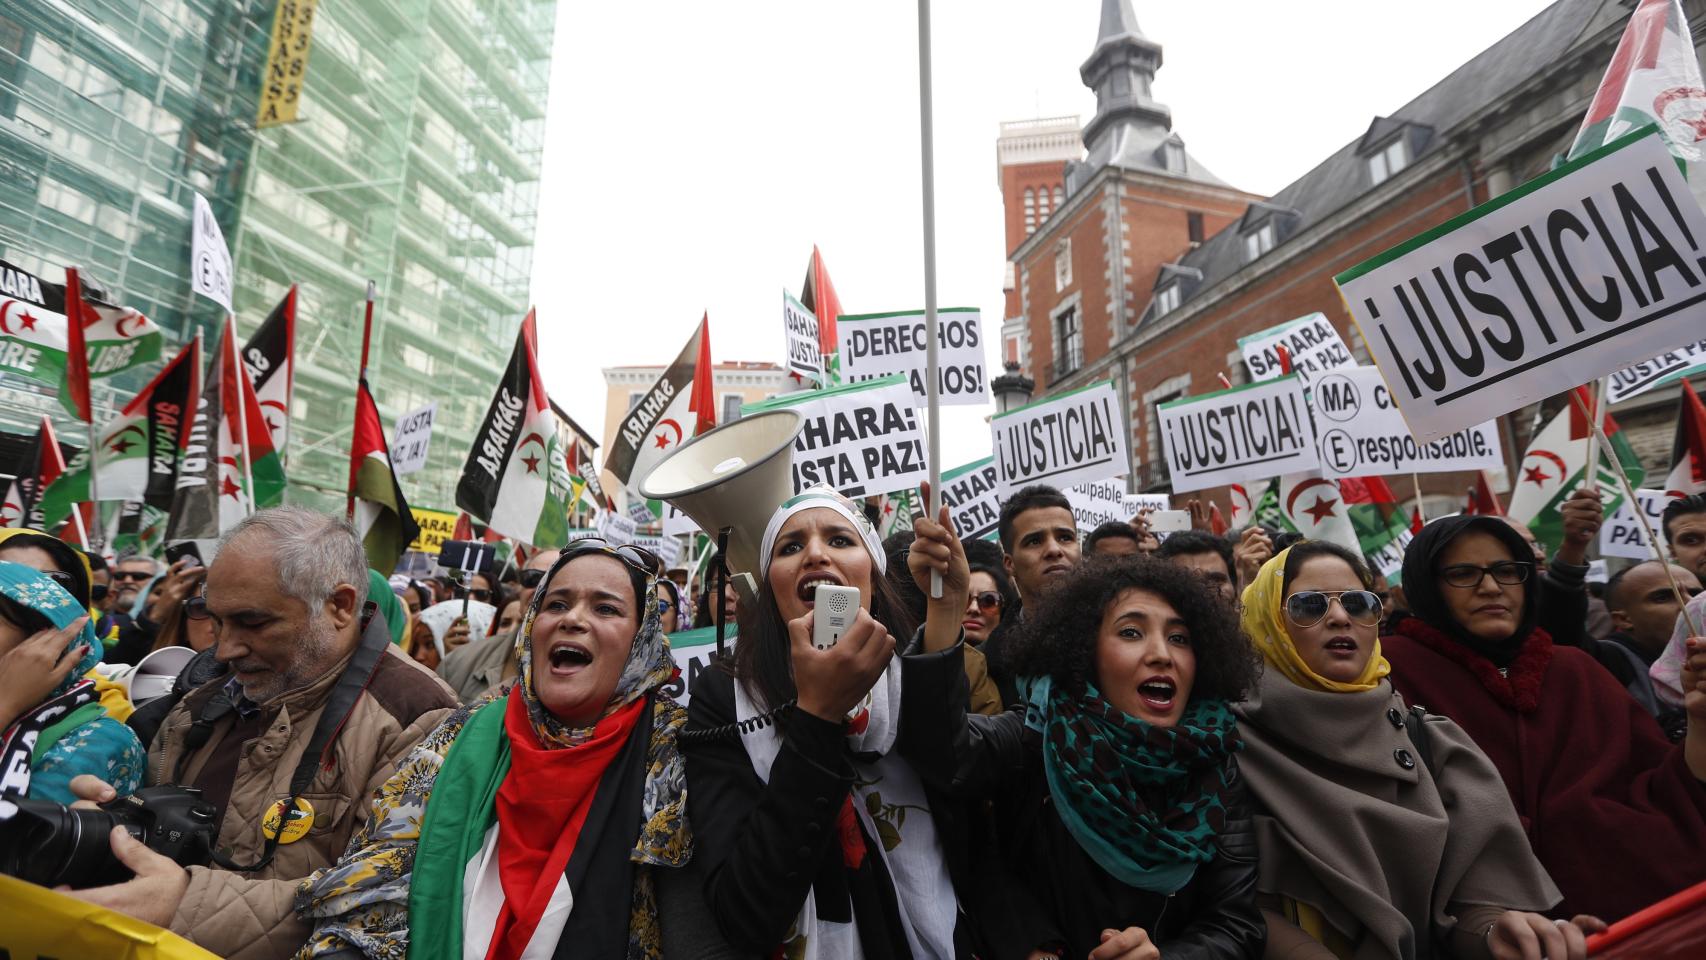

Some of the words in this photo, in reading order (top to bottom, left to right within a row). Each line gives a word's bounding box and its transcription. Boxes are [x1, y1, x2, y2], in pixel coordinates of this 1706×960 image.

[1364, 166, 1706, 399] ¡JUSTICIA!
[1167, 392, 1305, 472] ¡JUSTICIA!
[1322, 382, 1358, 413] MA
[151, 401, 179, 476] SAHARA
[862, 438, 926, 480] PAZ!
[997, 397, 1115, 481] ¡JUSTICIA!
[1330, 436, 1348, 467] E
